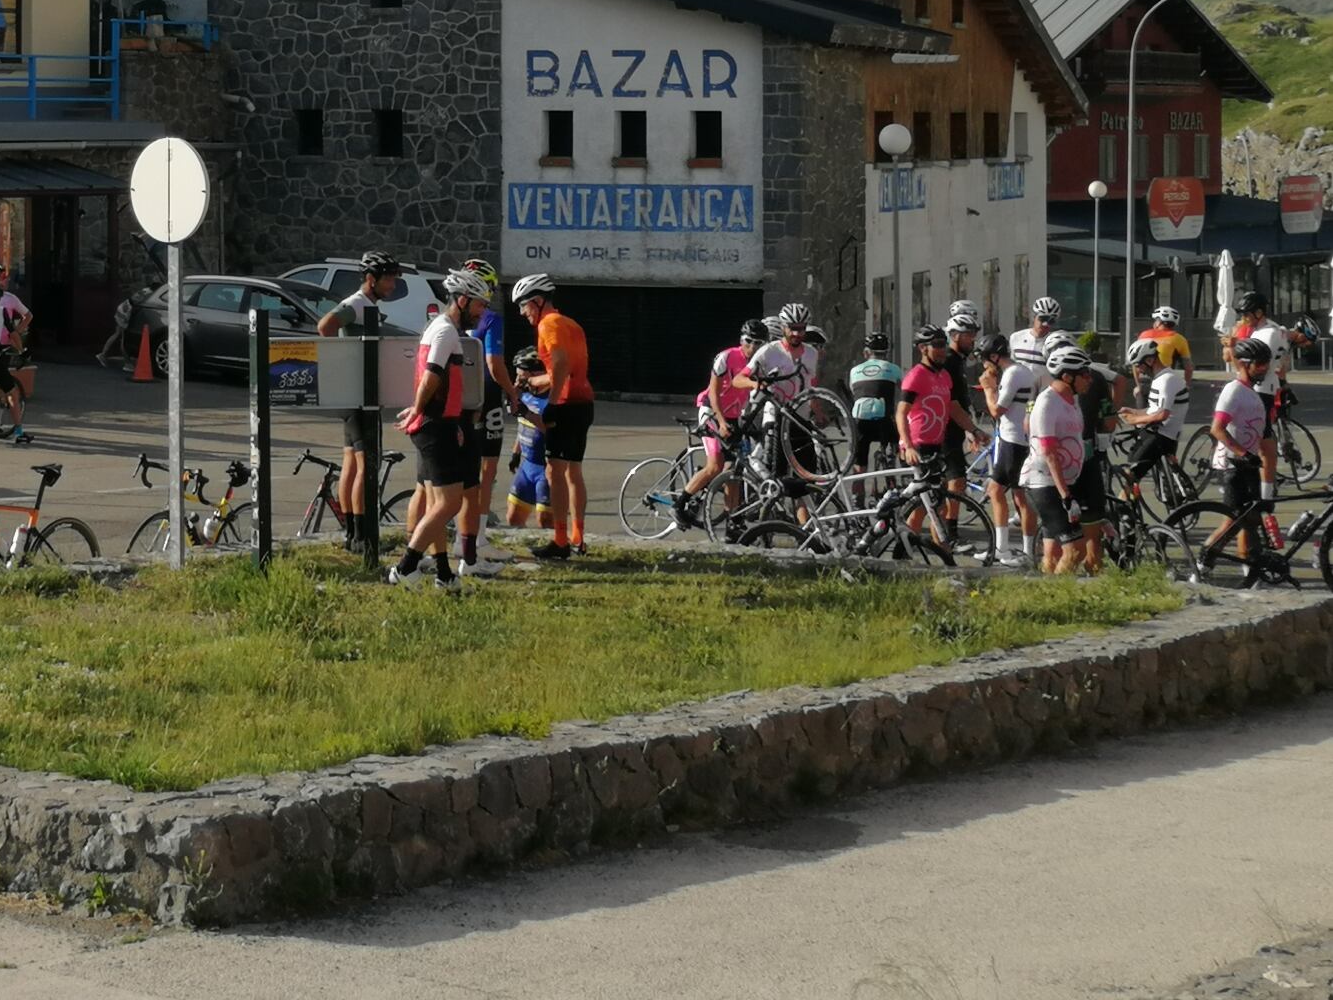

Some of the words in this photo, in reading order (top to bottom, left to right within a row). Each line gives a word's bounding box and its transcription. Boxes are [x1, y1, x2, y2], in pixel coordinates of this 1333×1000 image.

[526, 49, 738, 98] BAZAR
[1170, 112, 1203, 130] BAZAR
[526, 246, 551, 259] ON
[569, 247, 631, 261] PARLE
